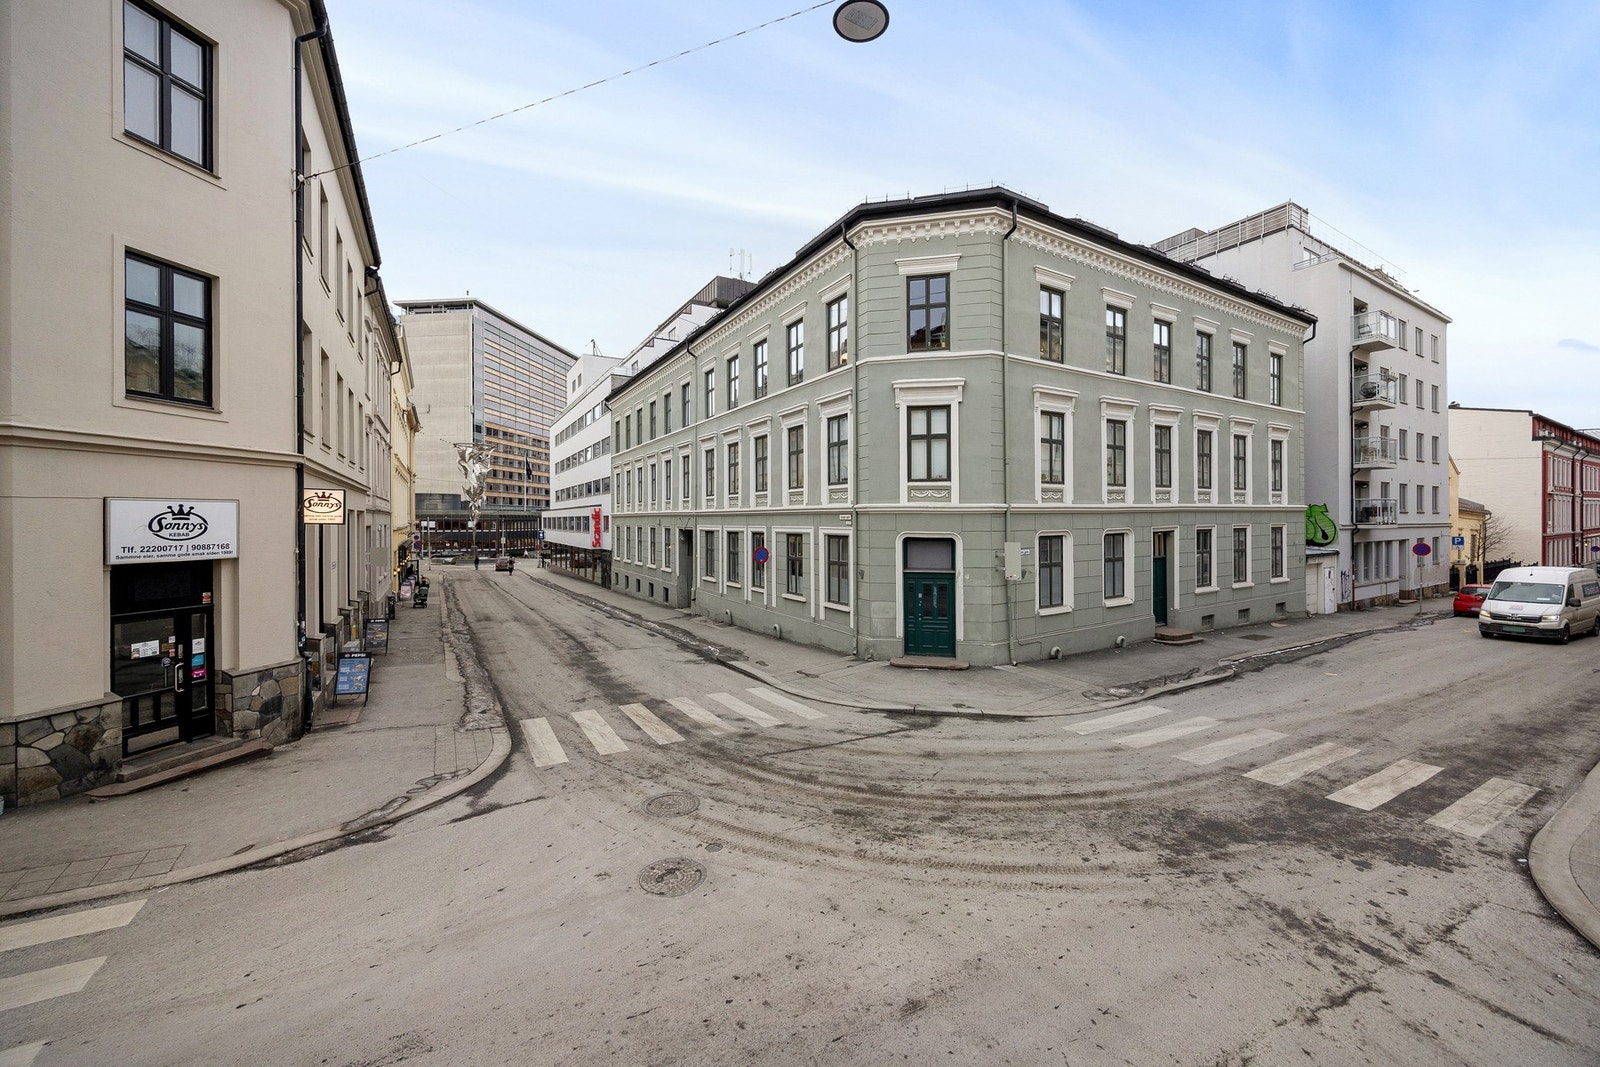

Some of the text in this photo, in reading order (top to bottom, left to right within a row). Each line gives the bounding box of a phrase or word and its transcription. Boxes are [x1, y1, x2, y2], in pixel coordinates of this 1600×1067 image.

[304, 499, 342, 509] Sonnys
[148, 516, 208, 533] Sonnys
[592, 507, 601, 547] Scandic
[1454, 537, 1462, 545] P
[120, 545, 137, 553] Tlf.
[139, 544, 184, 553] 22200717
[191, 543, 230, 551] 90887168
